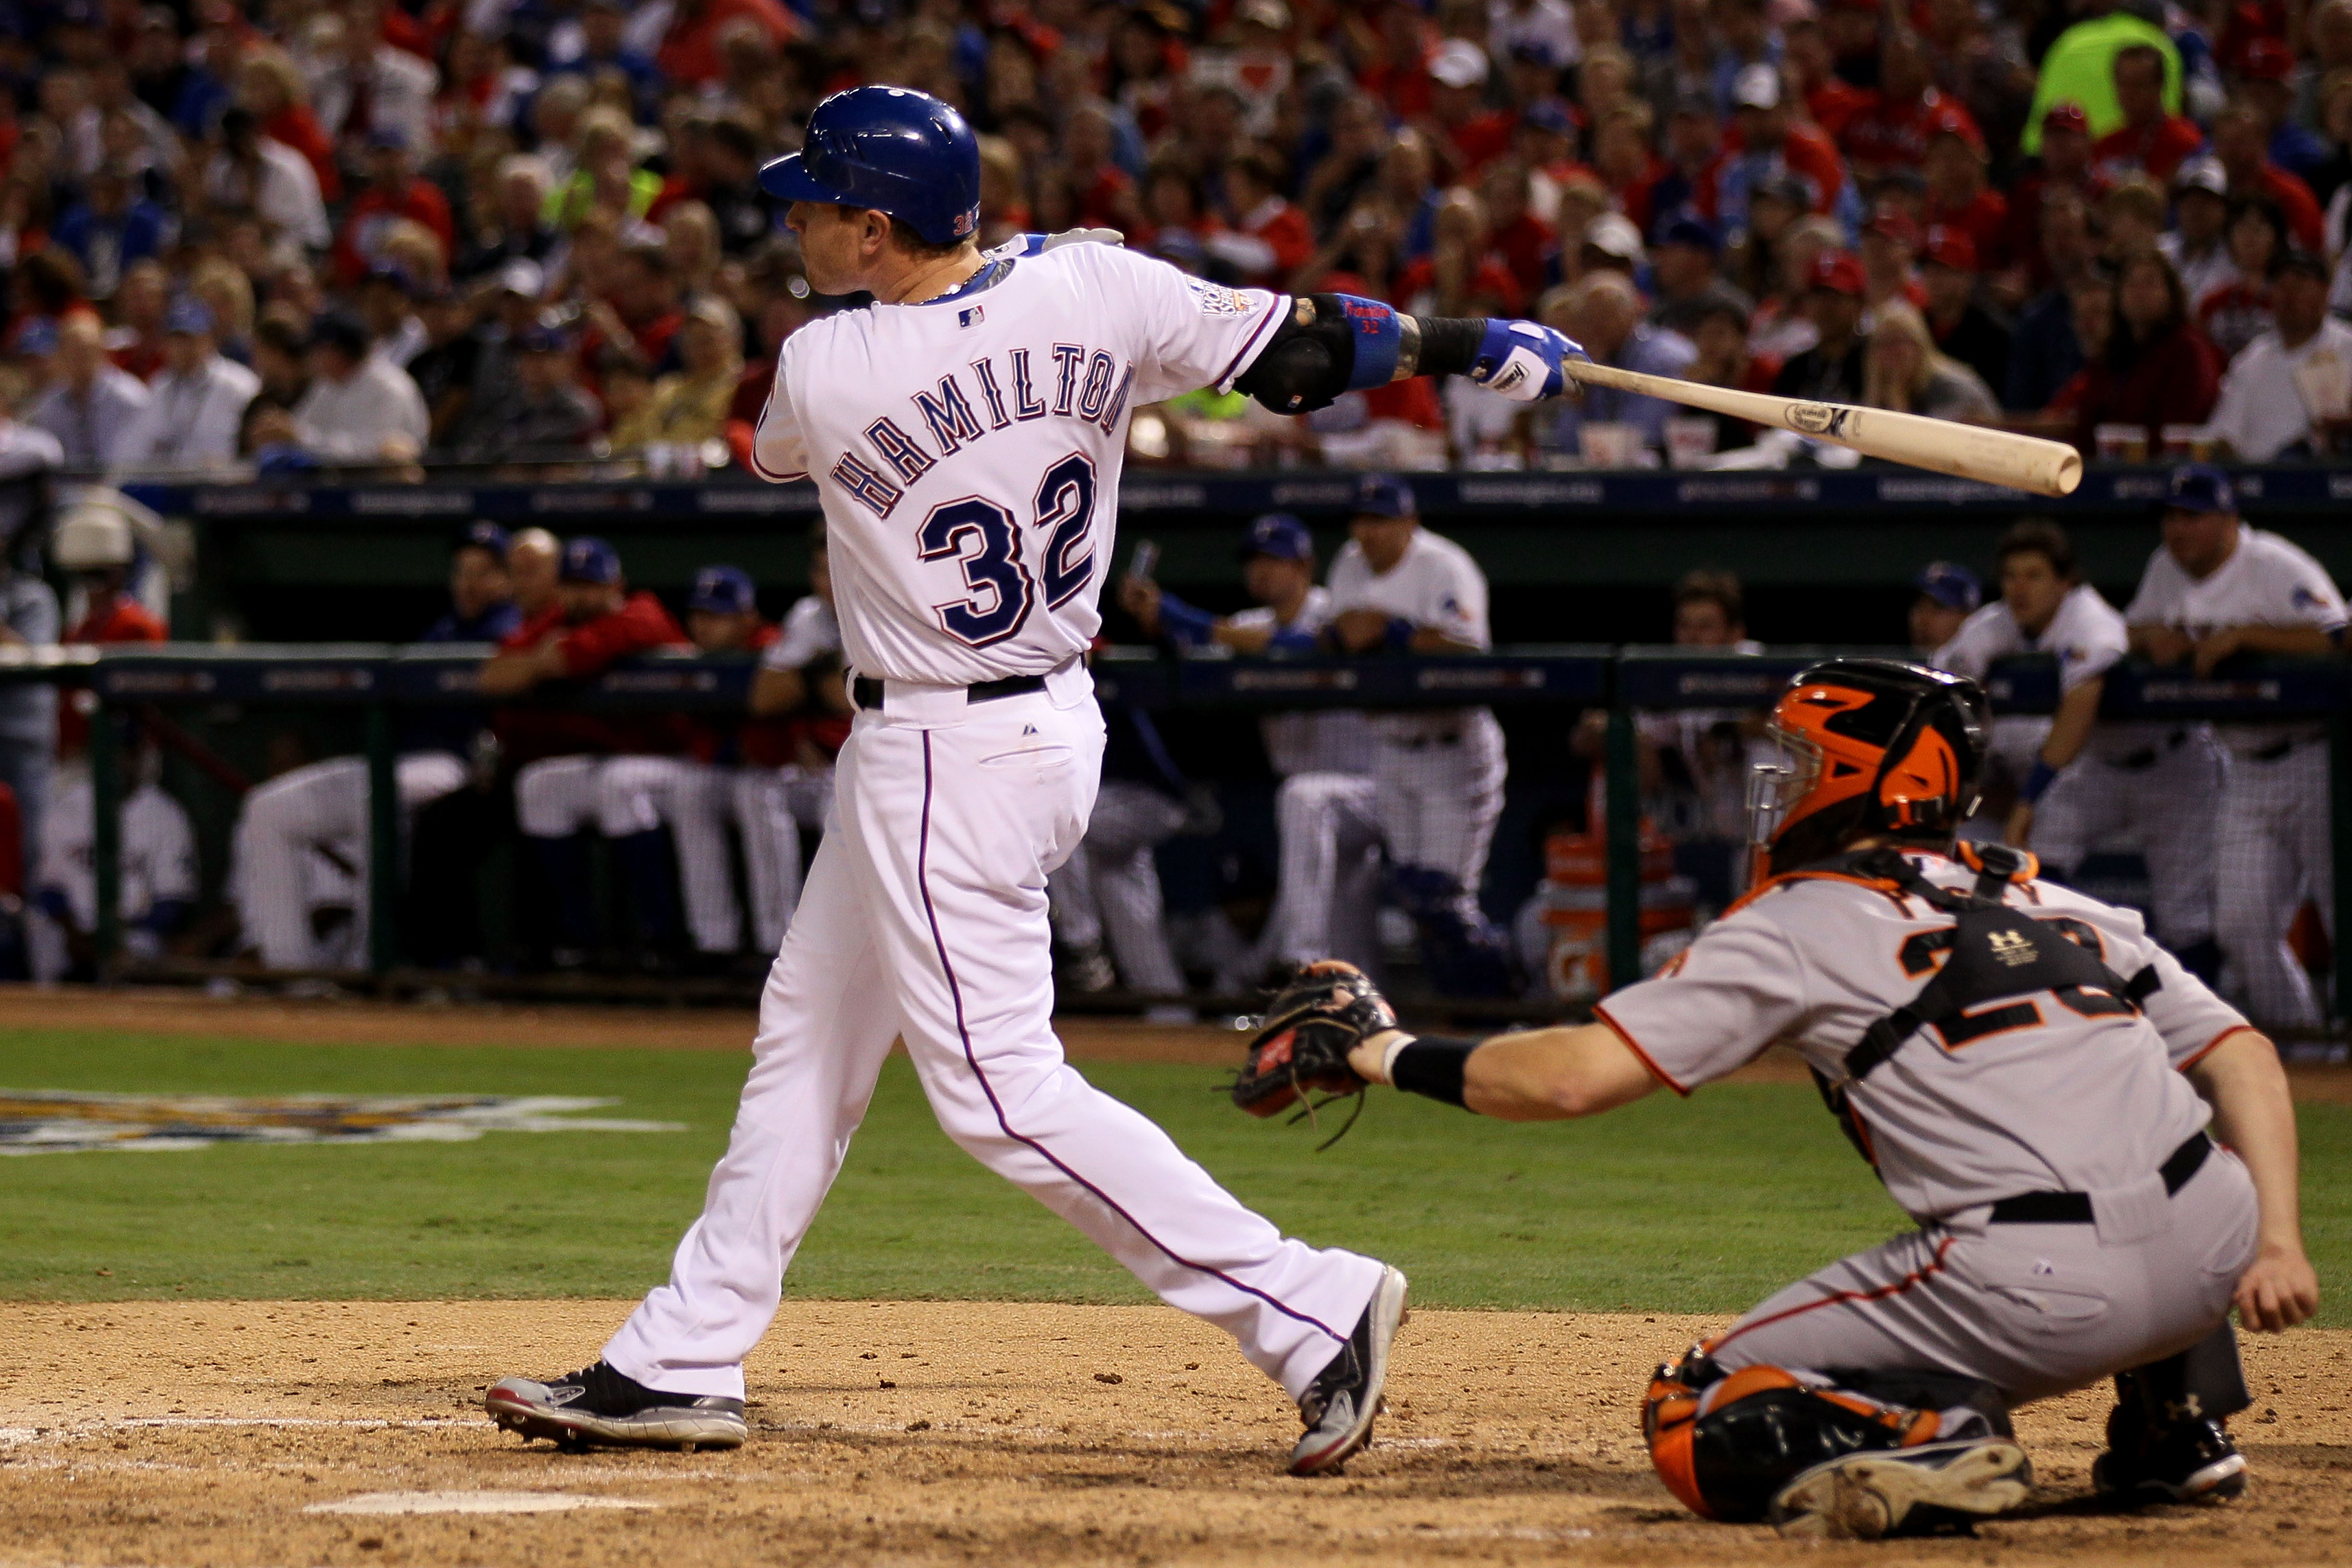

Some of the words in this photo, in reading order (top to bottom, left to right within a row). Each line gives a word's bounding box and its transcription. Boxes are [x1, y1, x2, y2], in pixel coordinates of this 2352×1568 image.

[1202, 281, 1222, 315] WORL
[1362, 319, 1379, 334] 32
[830, 342, 1133, 519] HAMILTON
[916, 451, 1097, 650] 32
